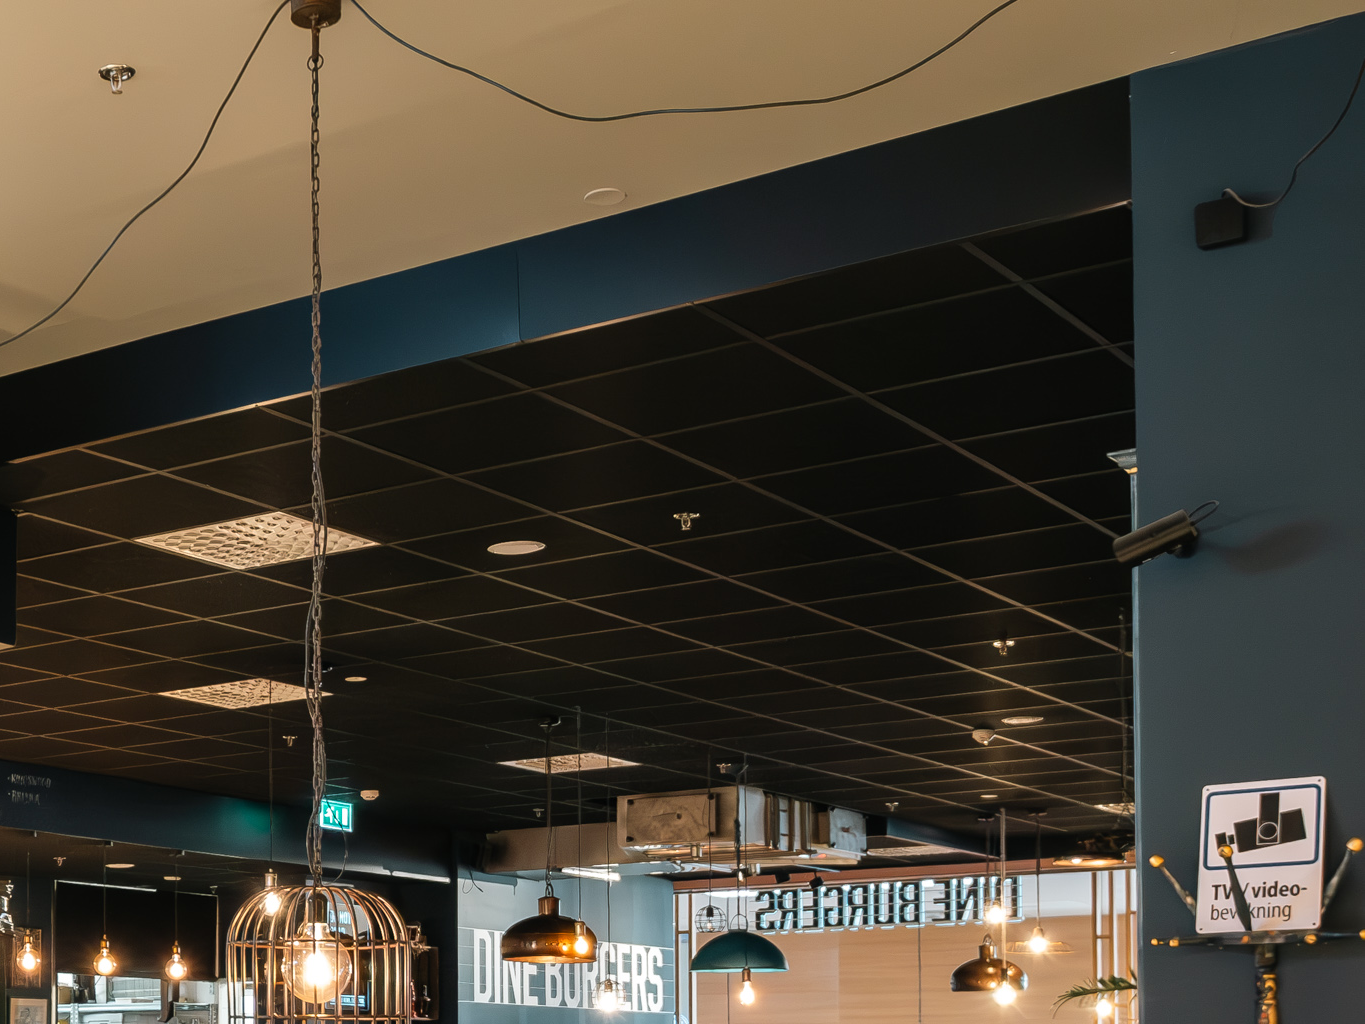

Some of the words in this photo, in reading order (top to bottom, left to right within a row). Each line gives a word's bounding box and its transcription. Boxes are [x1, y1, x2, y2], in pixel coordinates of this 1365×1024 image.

[1251, 880, 1308, 899] video-
[1209, 902, 1292, 922] bevkning
[544, 941, 664, 1013] BURGERS
